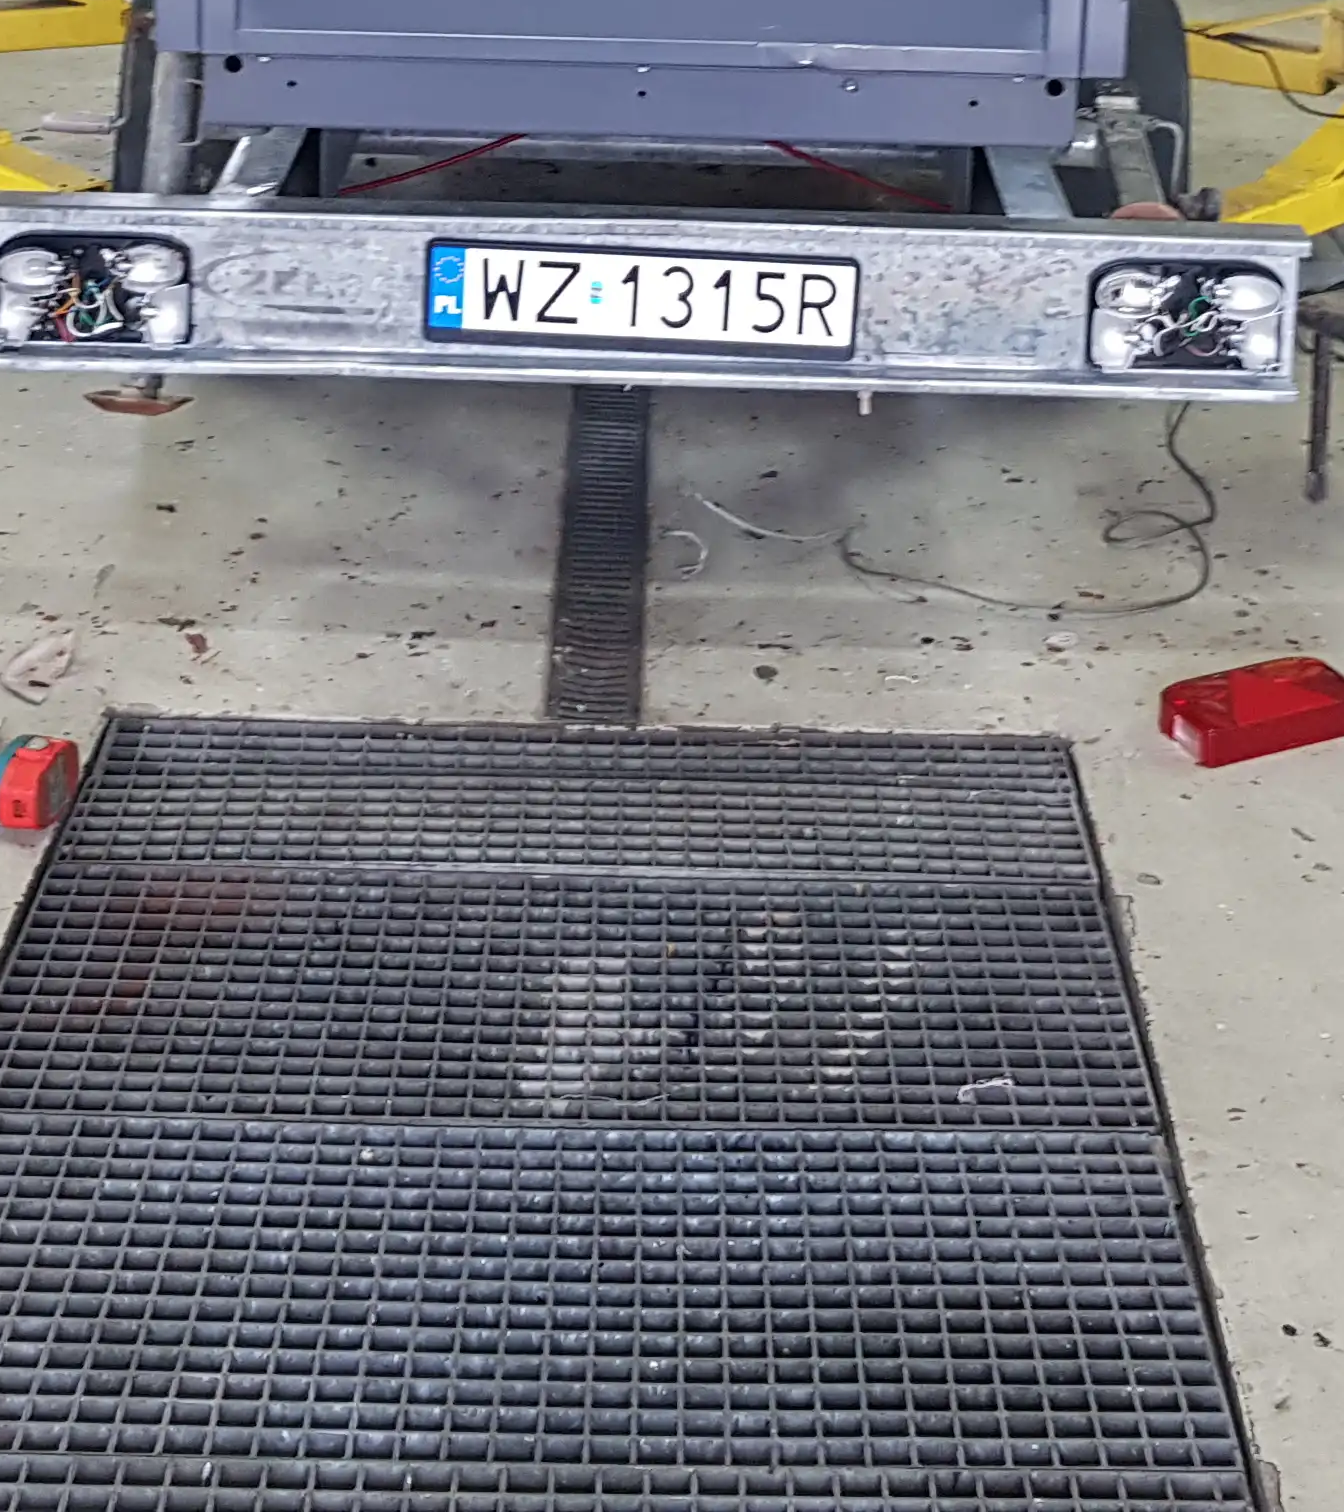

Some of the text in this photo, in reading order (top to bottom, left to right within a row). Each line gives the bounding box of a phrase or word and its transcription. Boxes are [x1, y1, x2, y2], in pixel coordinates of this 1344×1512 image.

[433, 294, 463, 316] PL
[482, 257, 838, 337] WZ 1315R
